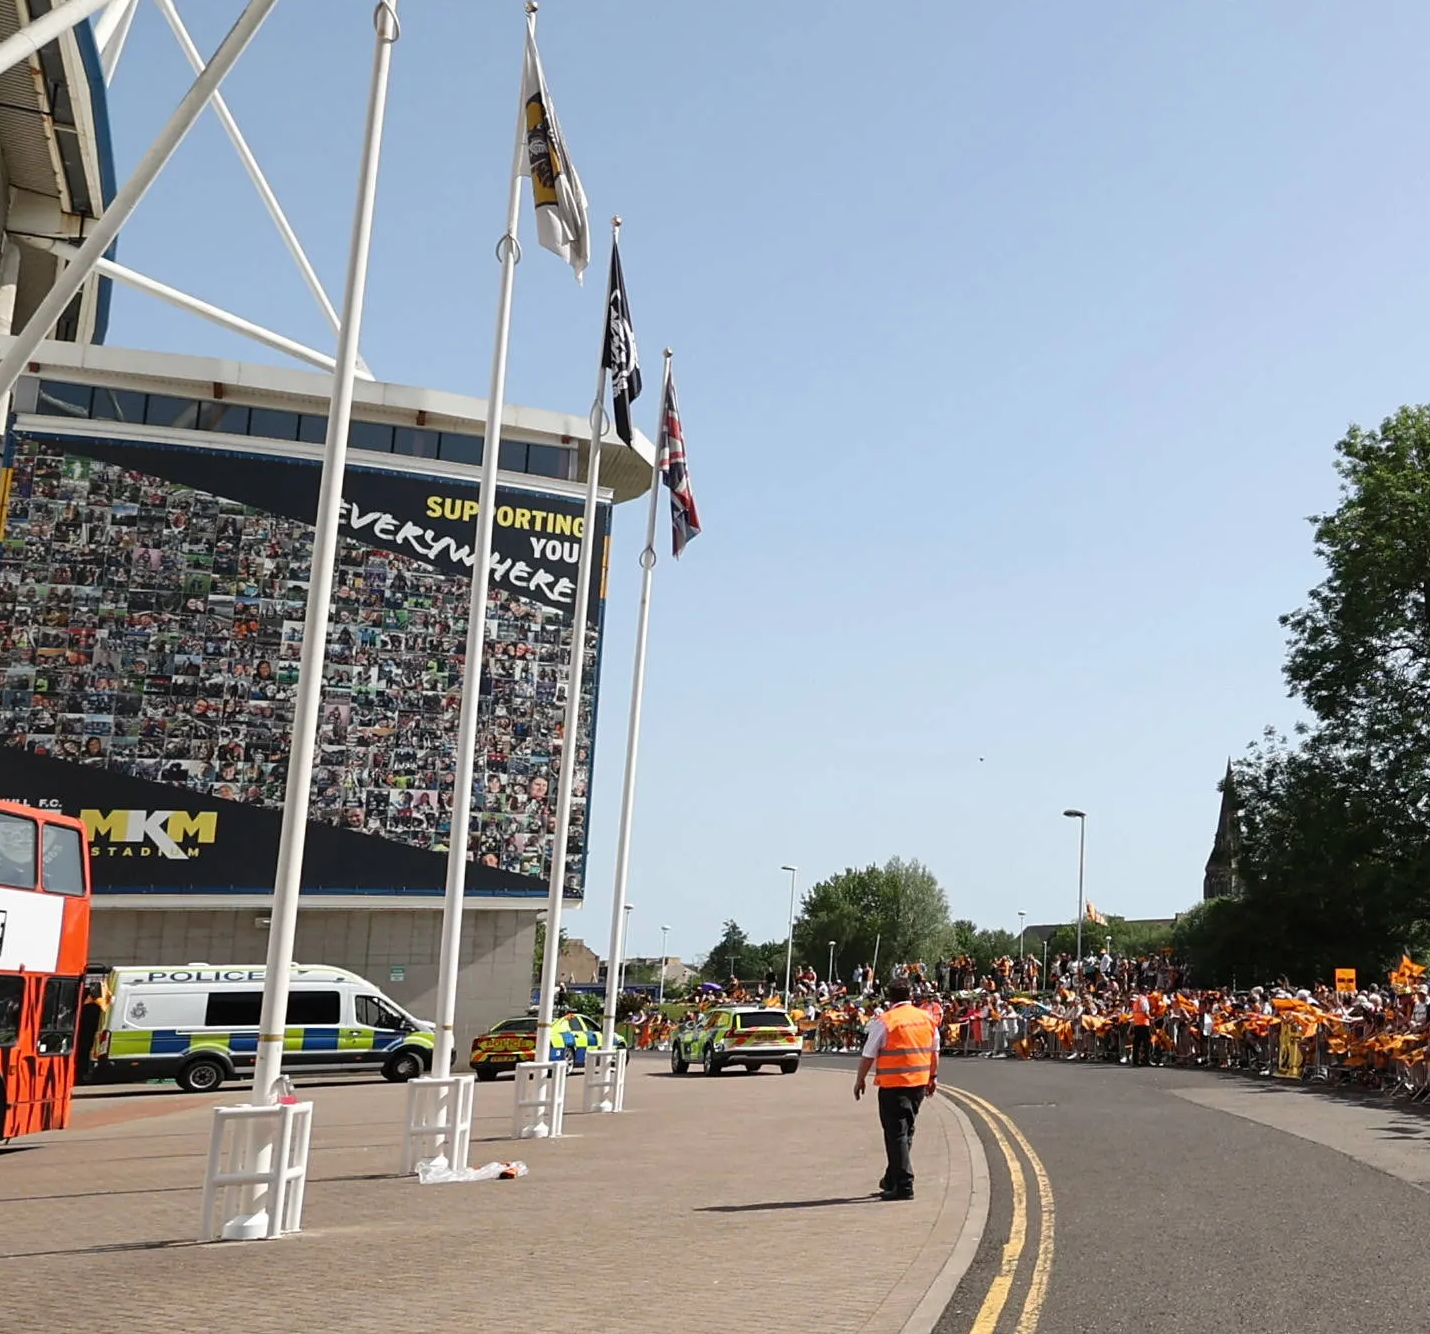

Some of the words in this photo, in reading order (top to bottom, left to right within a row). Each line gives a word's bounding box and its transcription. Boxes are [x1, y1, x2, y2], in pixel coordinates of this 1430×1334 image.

[426, 495, 586, 538] SUPORTING
[81, 809, 218, 859] MKM
[148, 970, 267, 983] POLICE
